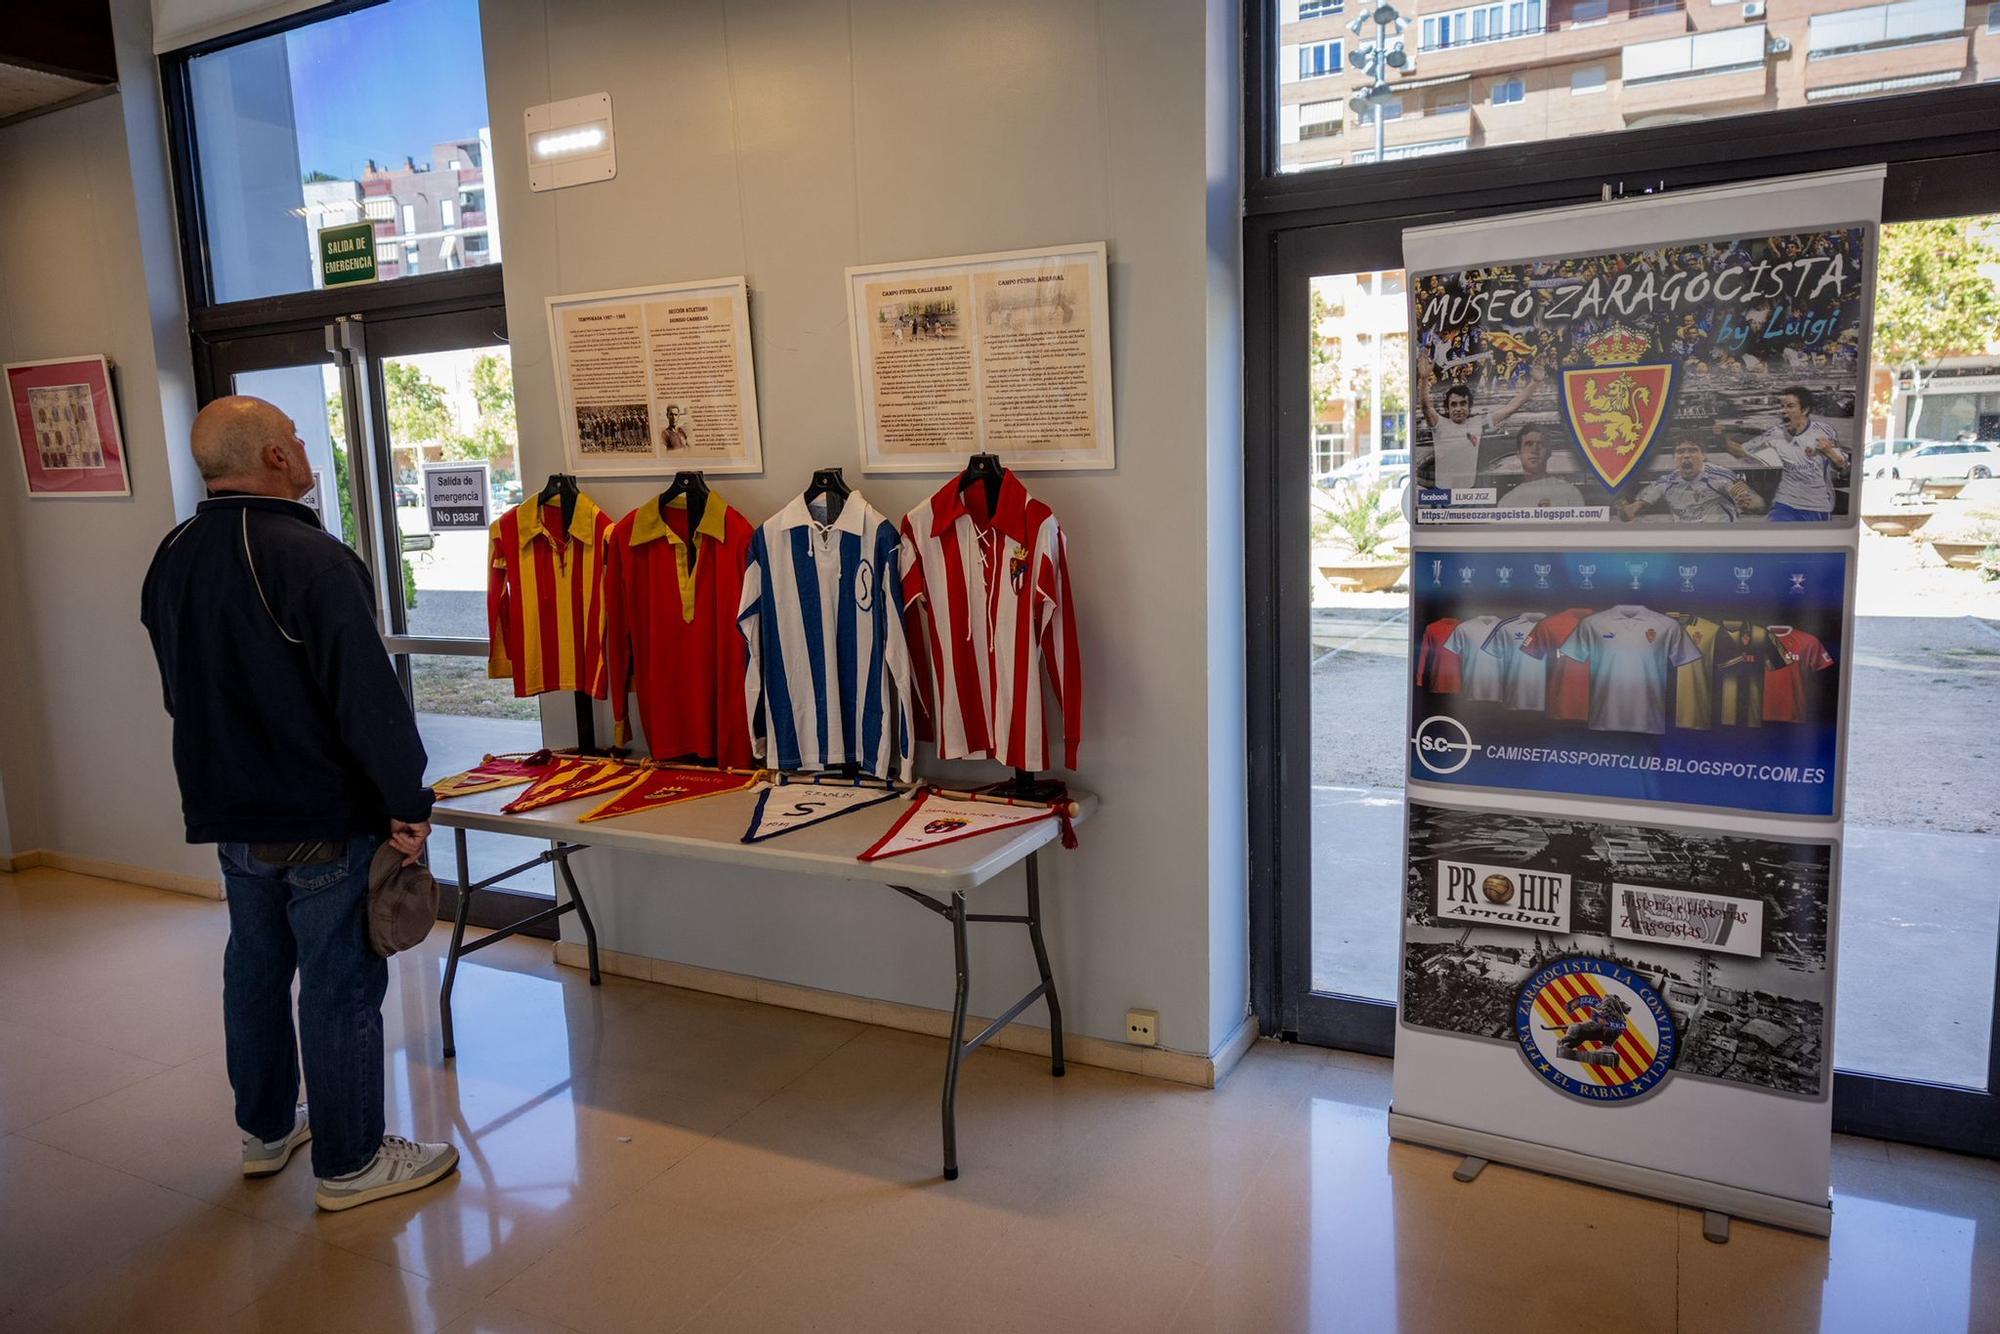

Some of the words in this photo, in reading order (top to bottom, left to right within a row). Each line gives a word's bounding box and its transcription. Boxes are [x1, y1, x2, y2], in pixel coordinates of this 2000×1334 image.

[328, 239, 354, 255] SALIDA
[355, 237, 366, 250] DE
[325, 256, 373, 274] EMERGENCIA
[881, 289, 899, 297] CAMPO
[1422, 289, 1534, 333] MUSEO
[1544, 252, 1848, 320] ZARAGOCISTA
[1716, 314, 1750, 350] by
[1763, 305, 1841, 345] Luigi
[437, 476, 461, 486] Salida
[463, 475, 473, 485] de
[434, 491, 478, 504] emergencia
[1420, 493, 1449, 501] facebook
[436, 511, 450, 522] No
[452, 512, 479, 524] pasar
[1421, 508, 1603, 521] https://museozaragocista.blogspot.com/
[862, 568, 868, 600] S
[1486, 745, 1826, 784] CAMISETASSPORTCLUB.BLOGSPOT.COM.ES
[782, 802, 827, 817] S
[1449, 904, 1561, 927] Arrabal
[1621, 894, 1673, 914] Historia
[1677, 903, 1684, 913] e
[1687, 899, 1749, 924] Historias
[1620, 915, 1702, 939] Zaragocistas
[1520, 960, 1602, 1016] ZARAGOCISTA
[1613, 969, 1634, 985] LA
[1519, 1024, 1541, 1060] PEÑA
[1639, 987, 1672, 1084] CONVIVENCIA
[1552, 1074, 1570, 1088] EL
[1579, 1084, 1629, 1098] RABAL
